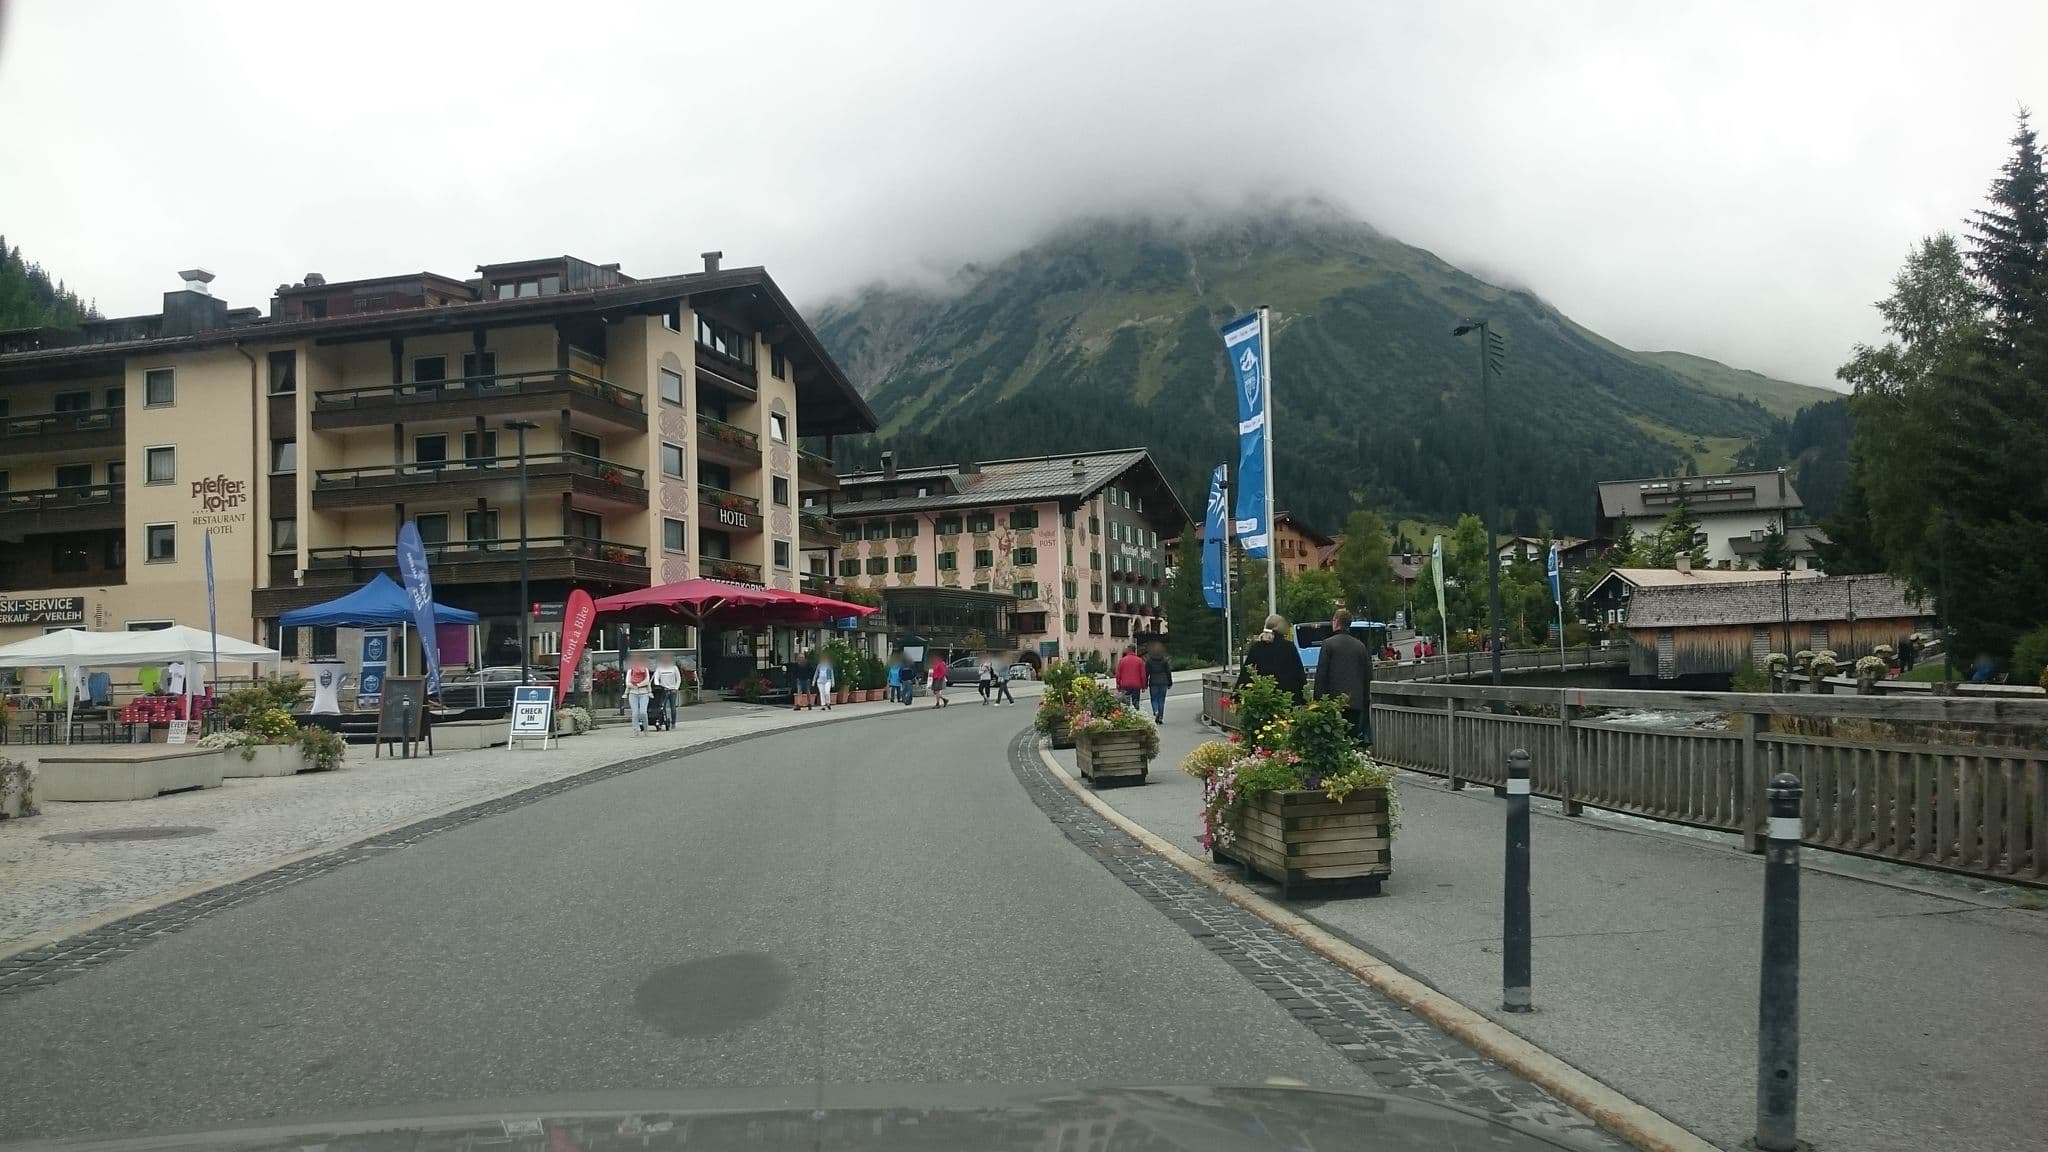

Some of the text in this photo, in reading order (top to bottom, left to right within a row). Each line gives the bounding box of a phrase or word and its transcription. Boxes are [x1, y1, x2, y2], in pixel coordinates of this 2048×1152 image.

[192, 513, 246, 525] RESTAURANT
[720, 508, 748, 528] HOTEL
[206, 525, 233, 535] HOTEL
[0, 598, 73, 612] SKI-SERVICE
[45, 611, 82, 621] VERLEIH
[562, 606, 589, 664] Rent a Bike
